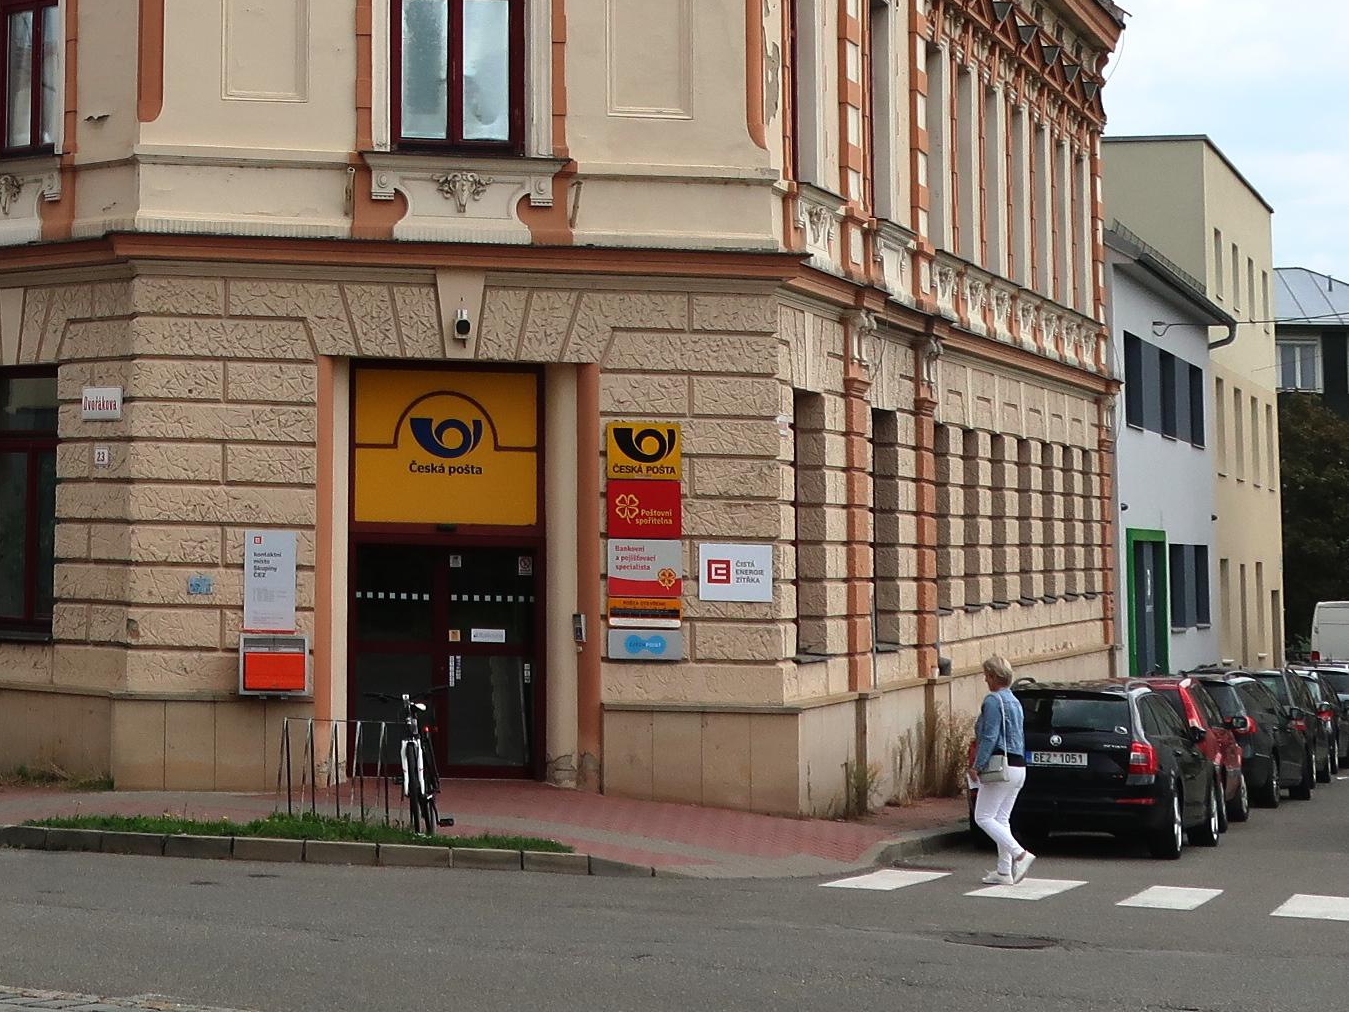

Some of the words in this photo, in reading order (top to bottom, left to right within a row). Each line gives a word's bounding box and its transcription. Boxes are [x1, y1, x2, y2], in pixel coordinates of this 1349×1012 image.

[83, 395, 117, 410] Dvořákova
[96, 451, 105, 462] 23
[409, 460, 445, 474] Česká
[448, 464, 483, 476] pošta
[612, 464, 643, 474] ČESKÁ
[646, 464, 676, 475] POŠTA
[641, 509, 672, 517] Poštovní
[636, 517, 673, 526] spořitelna
[735, 560, 756, 568] ČISTÁ
[735, 576, 760, 584] ZÍTŘKA
[1060, 754, 1083, 764] 1051
